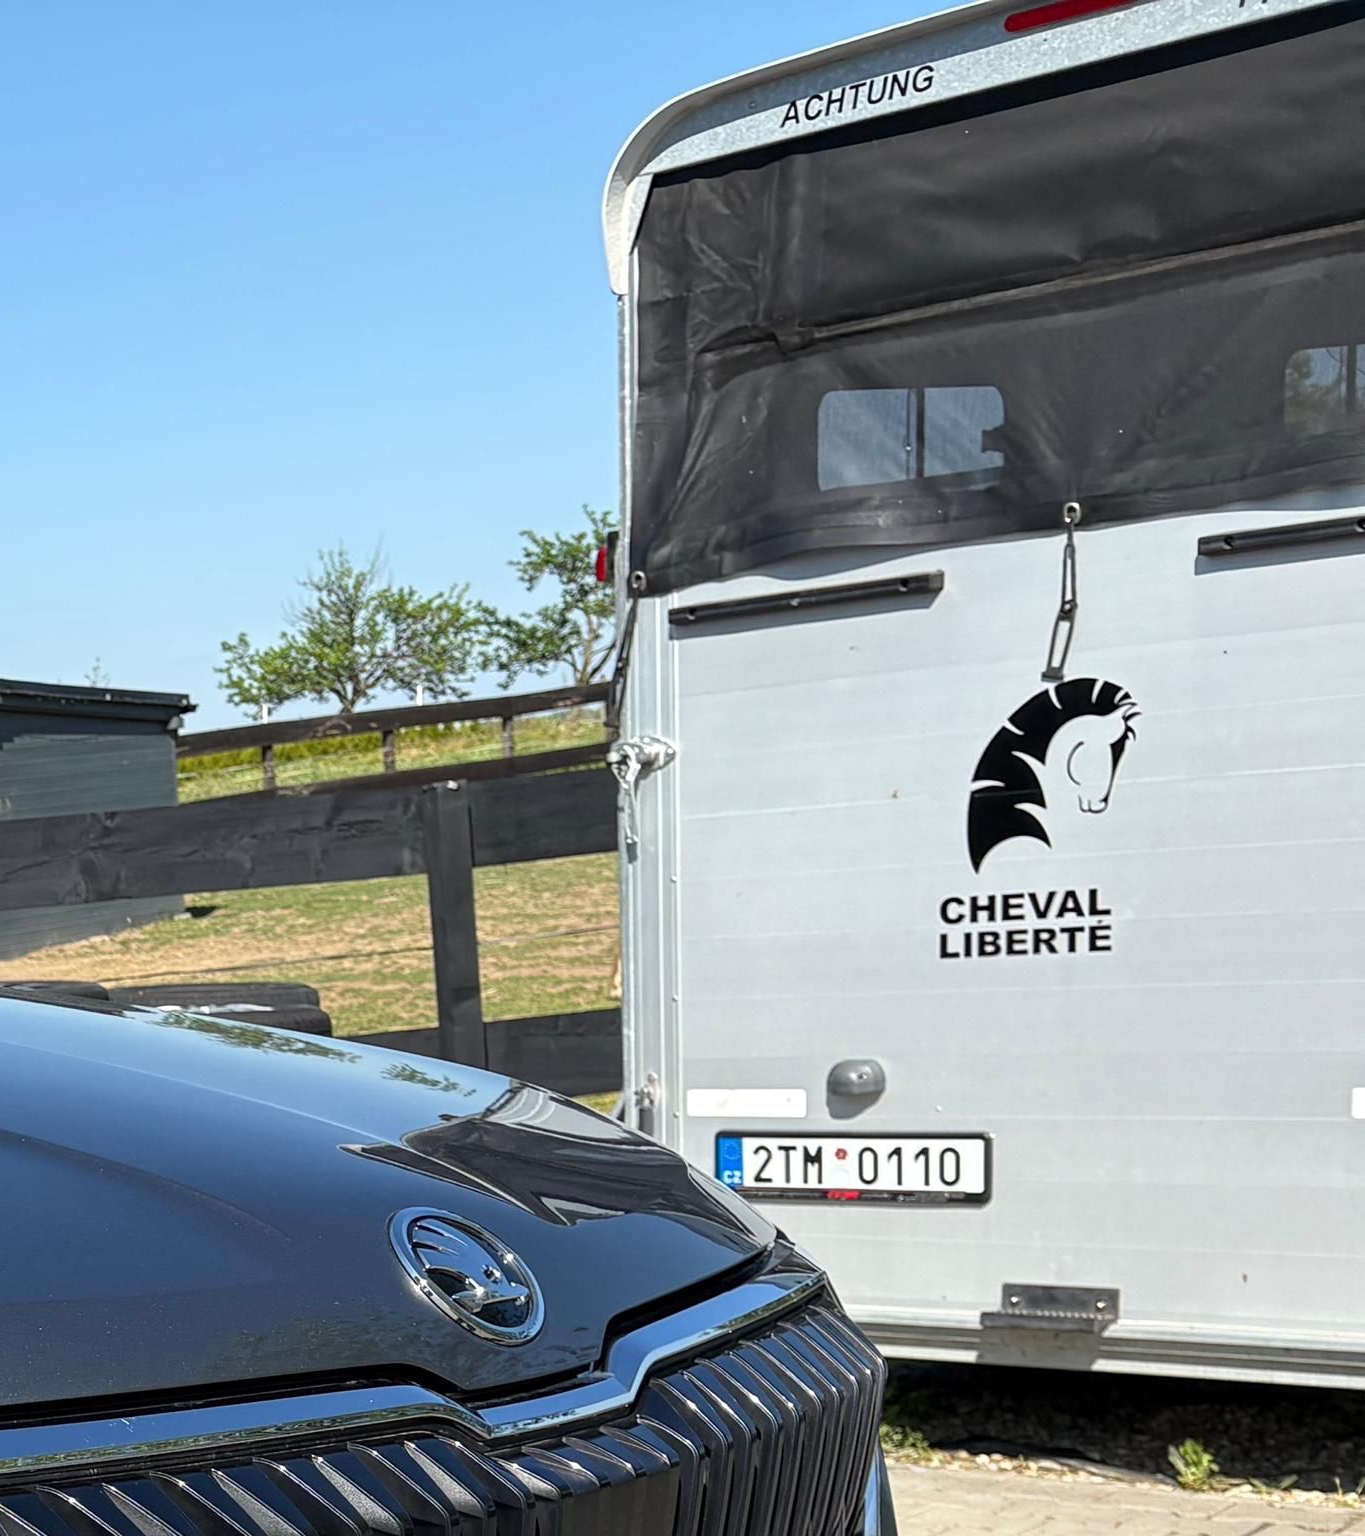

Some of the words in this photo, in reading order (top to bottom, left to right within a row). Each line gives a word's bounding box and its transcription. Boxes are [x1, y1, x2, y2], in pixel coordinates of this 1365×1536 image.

[779, 64, 935, 129] ACHTUNG
[939, 887, 1112, 925] CHEVAL
[939, 919, 1112, 959] LIBERTÉ
[723, 1170, 742, 1185] CZ
[752, 1144, 823, 1185] 2TM
[857, 1146, 961, 1187] 0110
